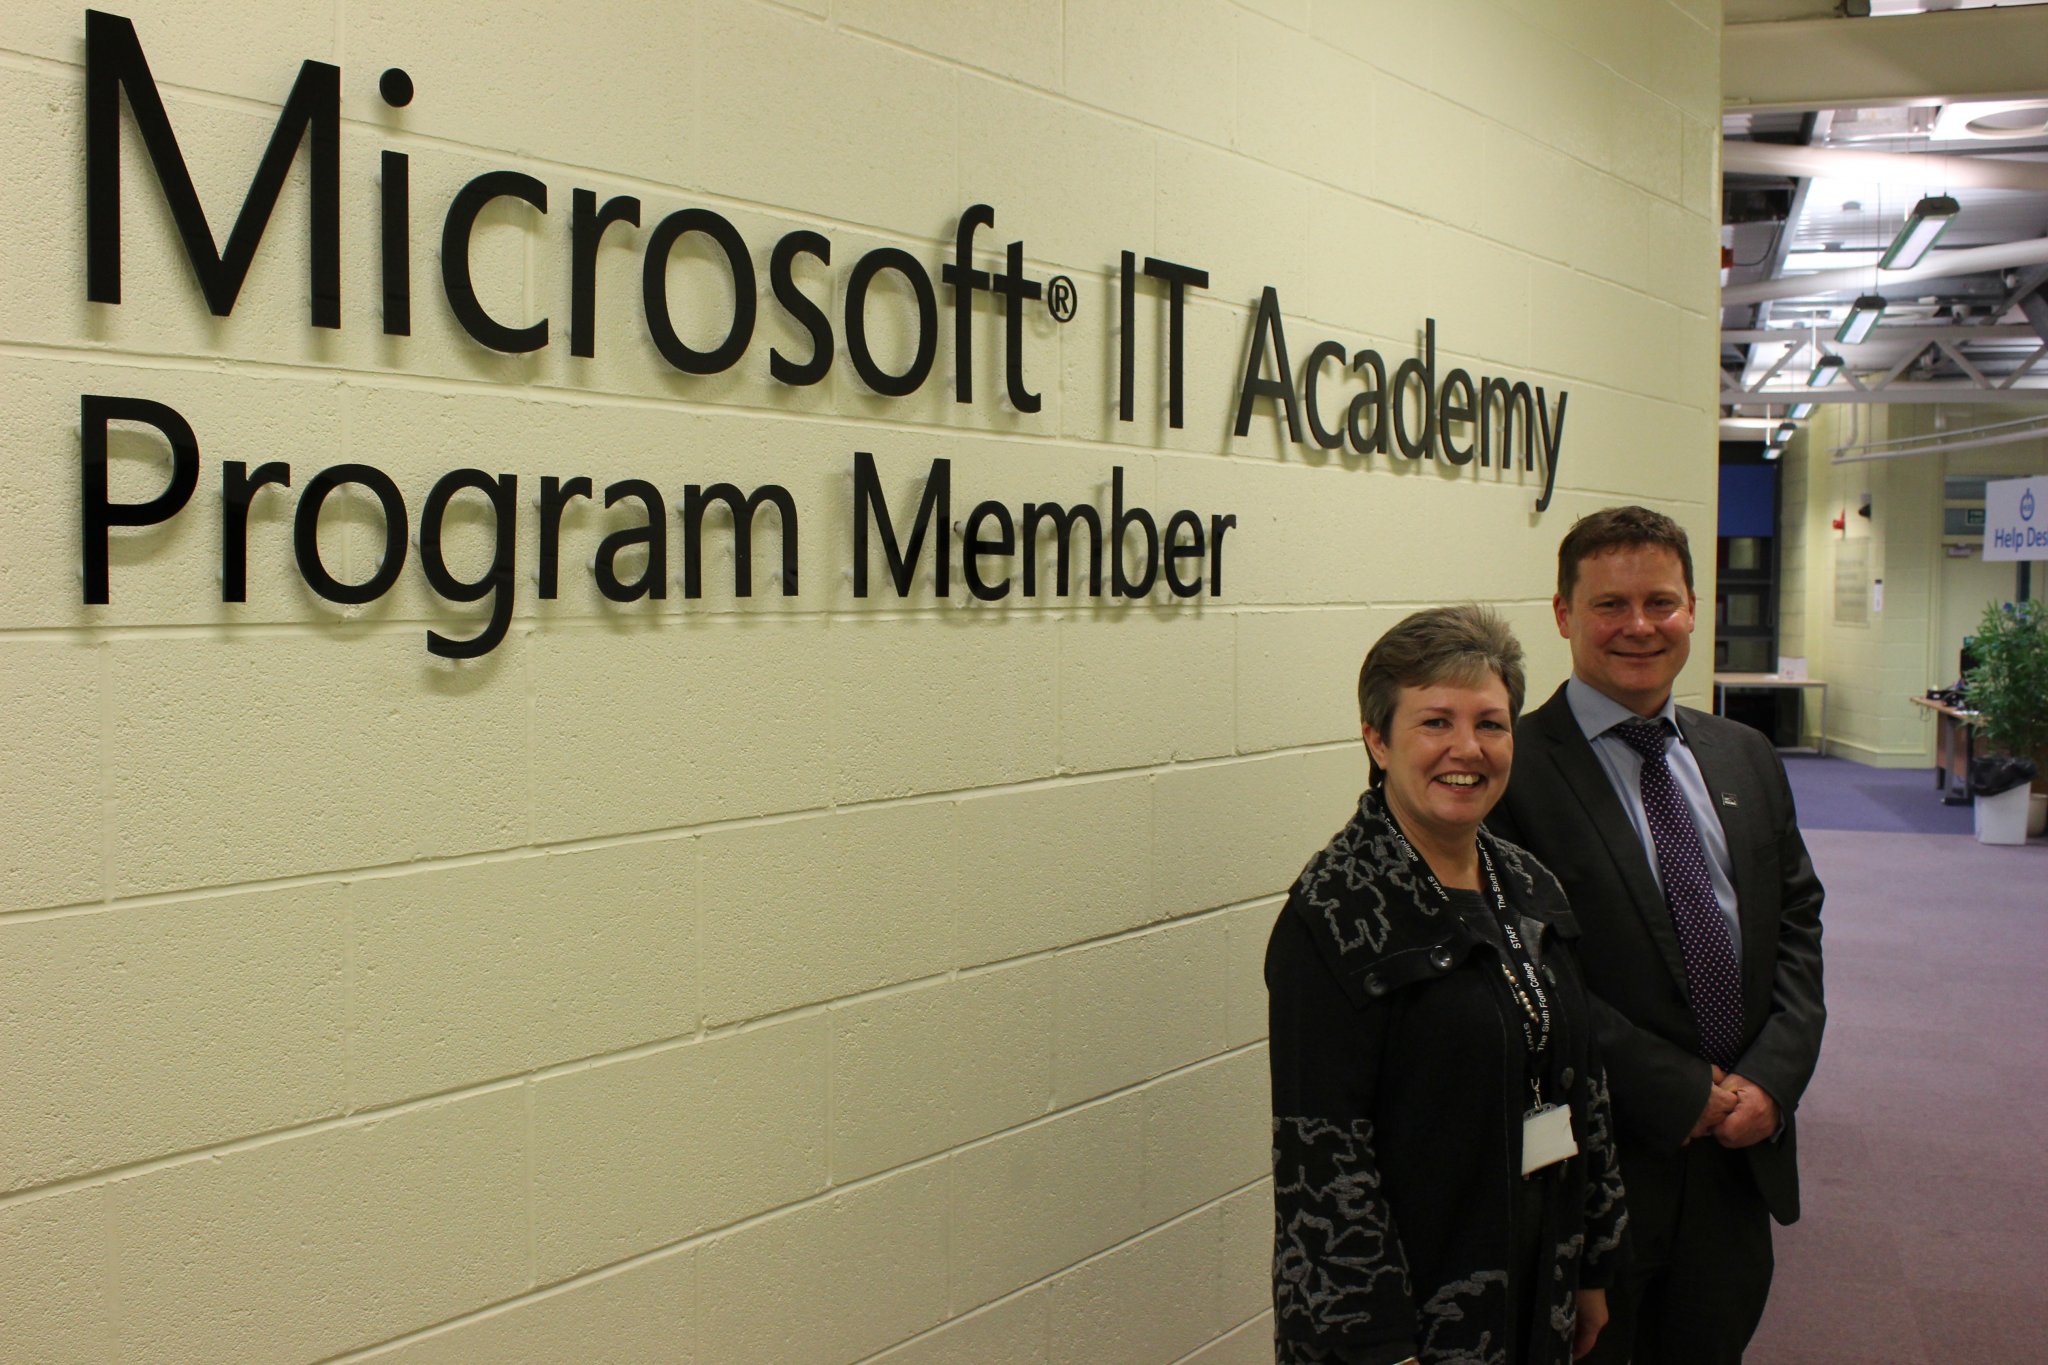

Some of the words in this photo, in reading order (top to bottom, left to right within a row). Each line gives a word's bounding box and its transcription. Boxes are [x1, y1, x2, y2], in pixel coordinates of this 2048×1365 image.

[1120, 250, 1209, 429] IT
[1229, 286, 1567, 513] Academy
[82, 394, 799, 660] Program
[853, 452, 1236, 602] Member
[1994, 527, 2024, 553] Help
[1396, 834, 1419, 862] College
[1482, 850, 1494, 872] Form
[1427, 875, 1450, 901] STAFF
[1489, 872, 1501, 892] Sixth
[1496, 894, 1506, 910] The
[1504, 924, 1521, 949] STAFF
[1522, 962, 1540, 988] College
[1534, 988, 1548, 1009] Form
[1541, 1010, 1550, 1033] Sixth
[1537, 1035, 1548, 1053] The
